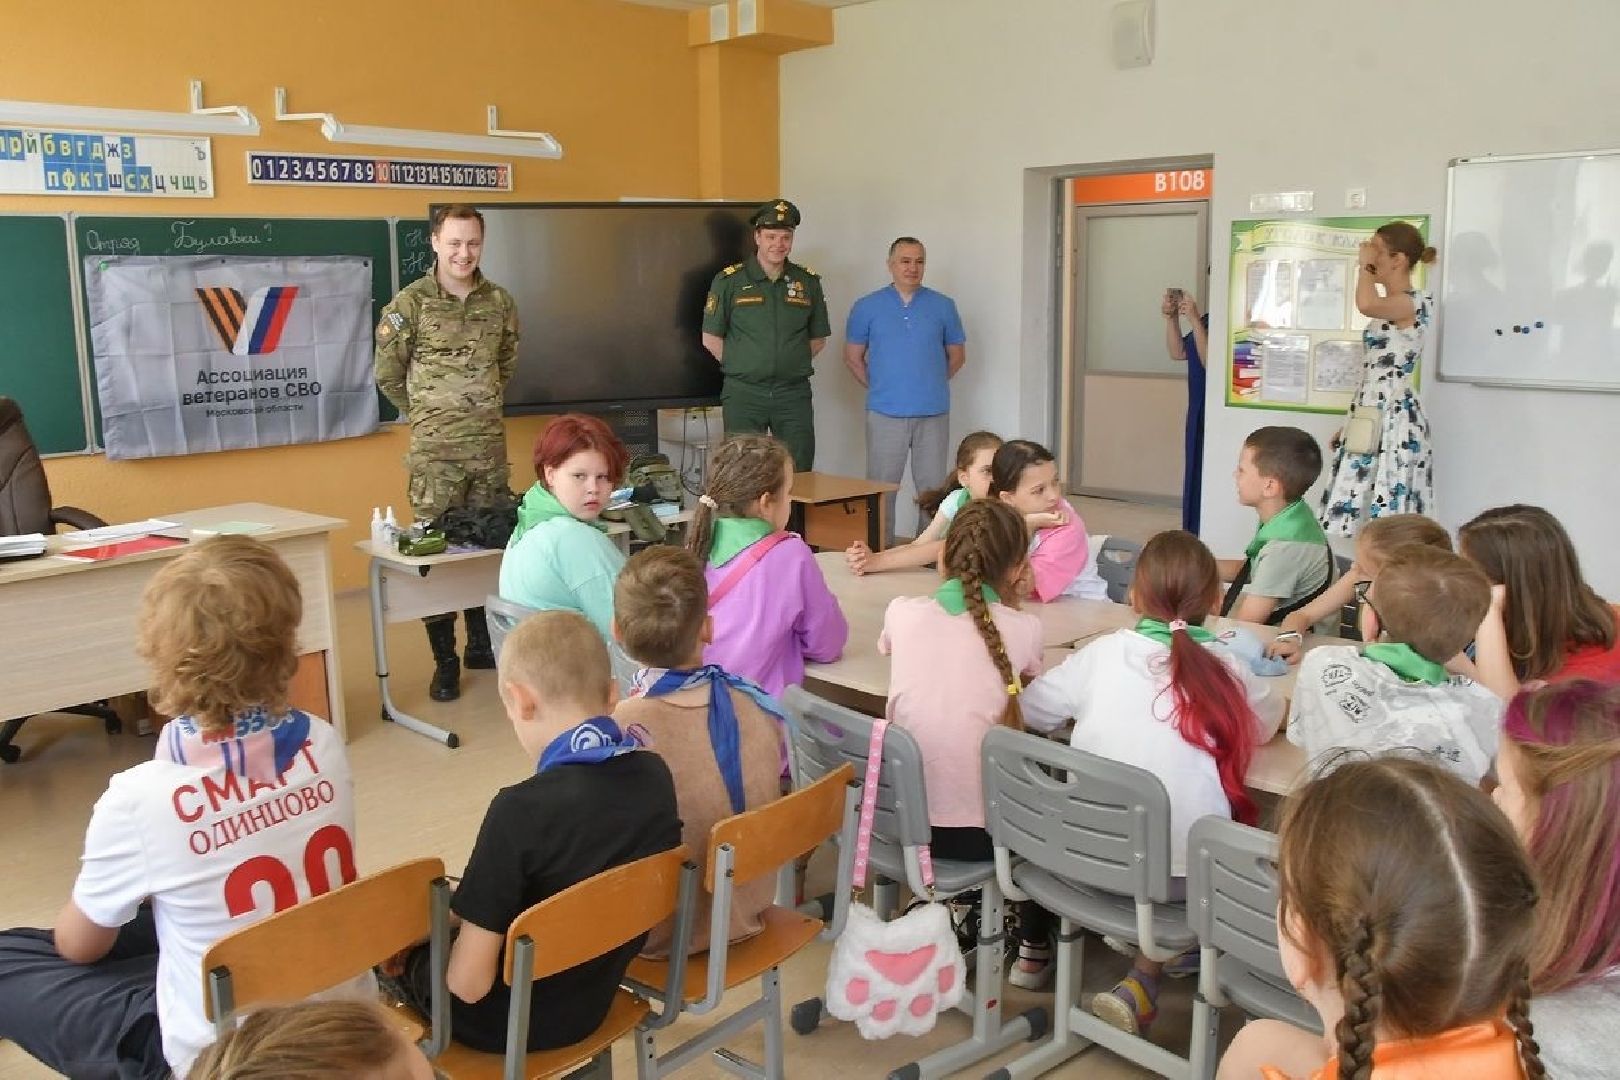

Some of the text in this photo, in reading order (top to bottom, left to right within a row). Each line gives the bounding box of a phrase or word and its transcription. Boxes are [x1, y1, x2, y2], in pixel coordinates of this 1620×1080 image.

[252, 158, 262, 179] 0
[266, 159, 275, 179] 1
[279, 159, 289, 179] 2
[292, 160, 301, 179] 3
[304, 161, 314, 180] 4
[317, 161, 327, 180] 5
[329, 162, 338, 180] 6
[341, 162, 350, 180] 7
[354, 162, 364, 181] 8
[366, 162, 374, 181] 9
[377, 163, 388, 182] 10
[390, 164, 400, 182] 11
[402, 164, 414, 183] 12
[415, 164, 426, 183] 13
[427, 165, 438, 183] 14
[440, 165, 450, 184] 15
[452, 166, 463, 184] 16
[464, 166, 473, 185] 17
[475, 167, 486, 185] 18
[486, 167, 496, 186] 19
[196, 367, 308, 385] Ассоциация
[182, 381, 323, 406] ветеранов СВО
[172, 738, 320, 824] СМТ
[188, 779, 335, 856] ОДИНЦОВО
